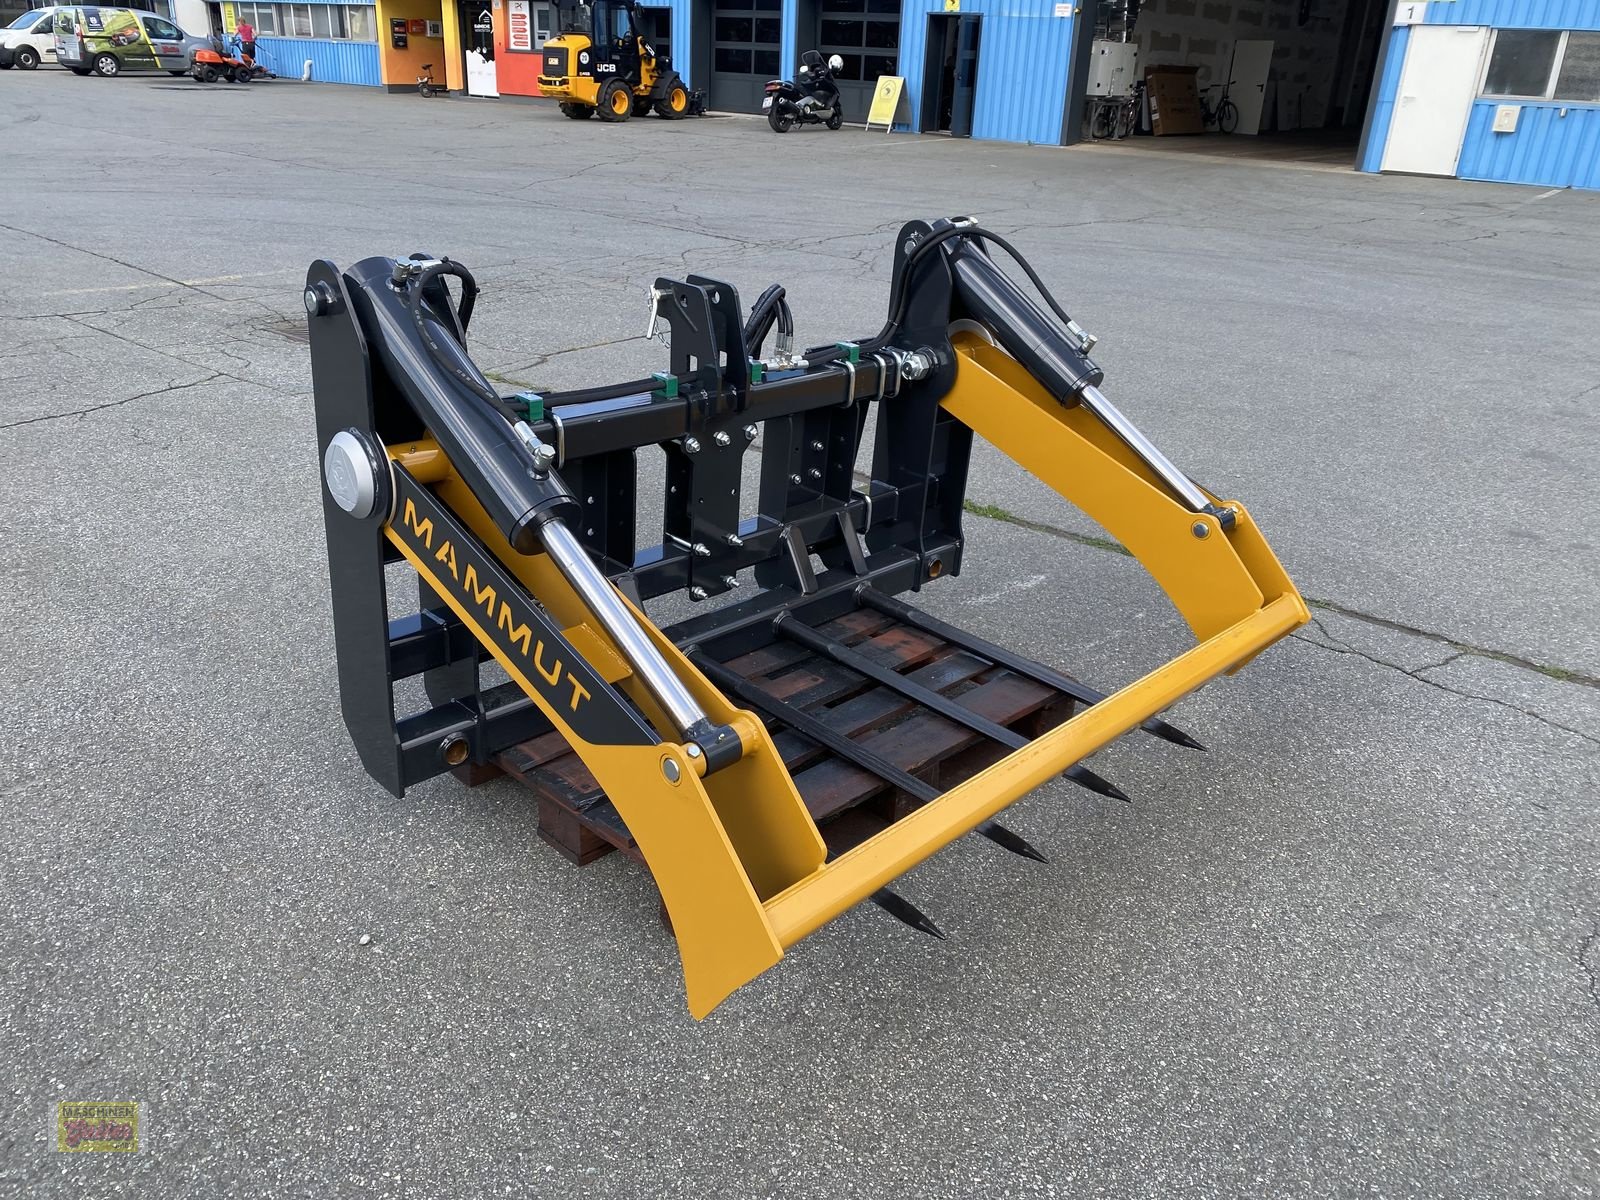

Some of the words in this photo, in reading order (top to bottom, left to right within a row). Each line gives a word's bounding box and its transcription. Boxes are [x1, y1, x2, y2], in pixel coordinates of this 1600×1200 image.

[1408, 5, 1414, 19] 1
[597, 64, 616, 72] JCB
[403, 497, 591, 712] MAMMUT
